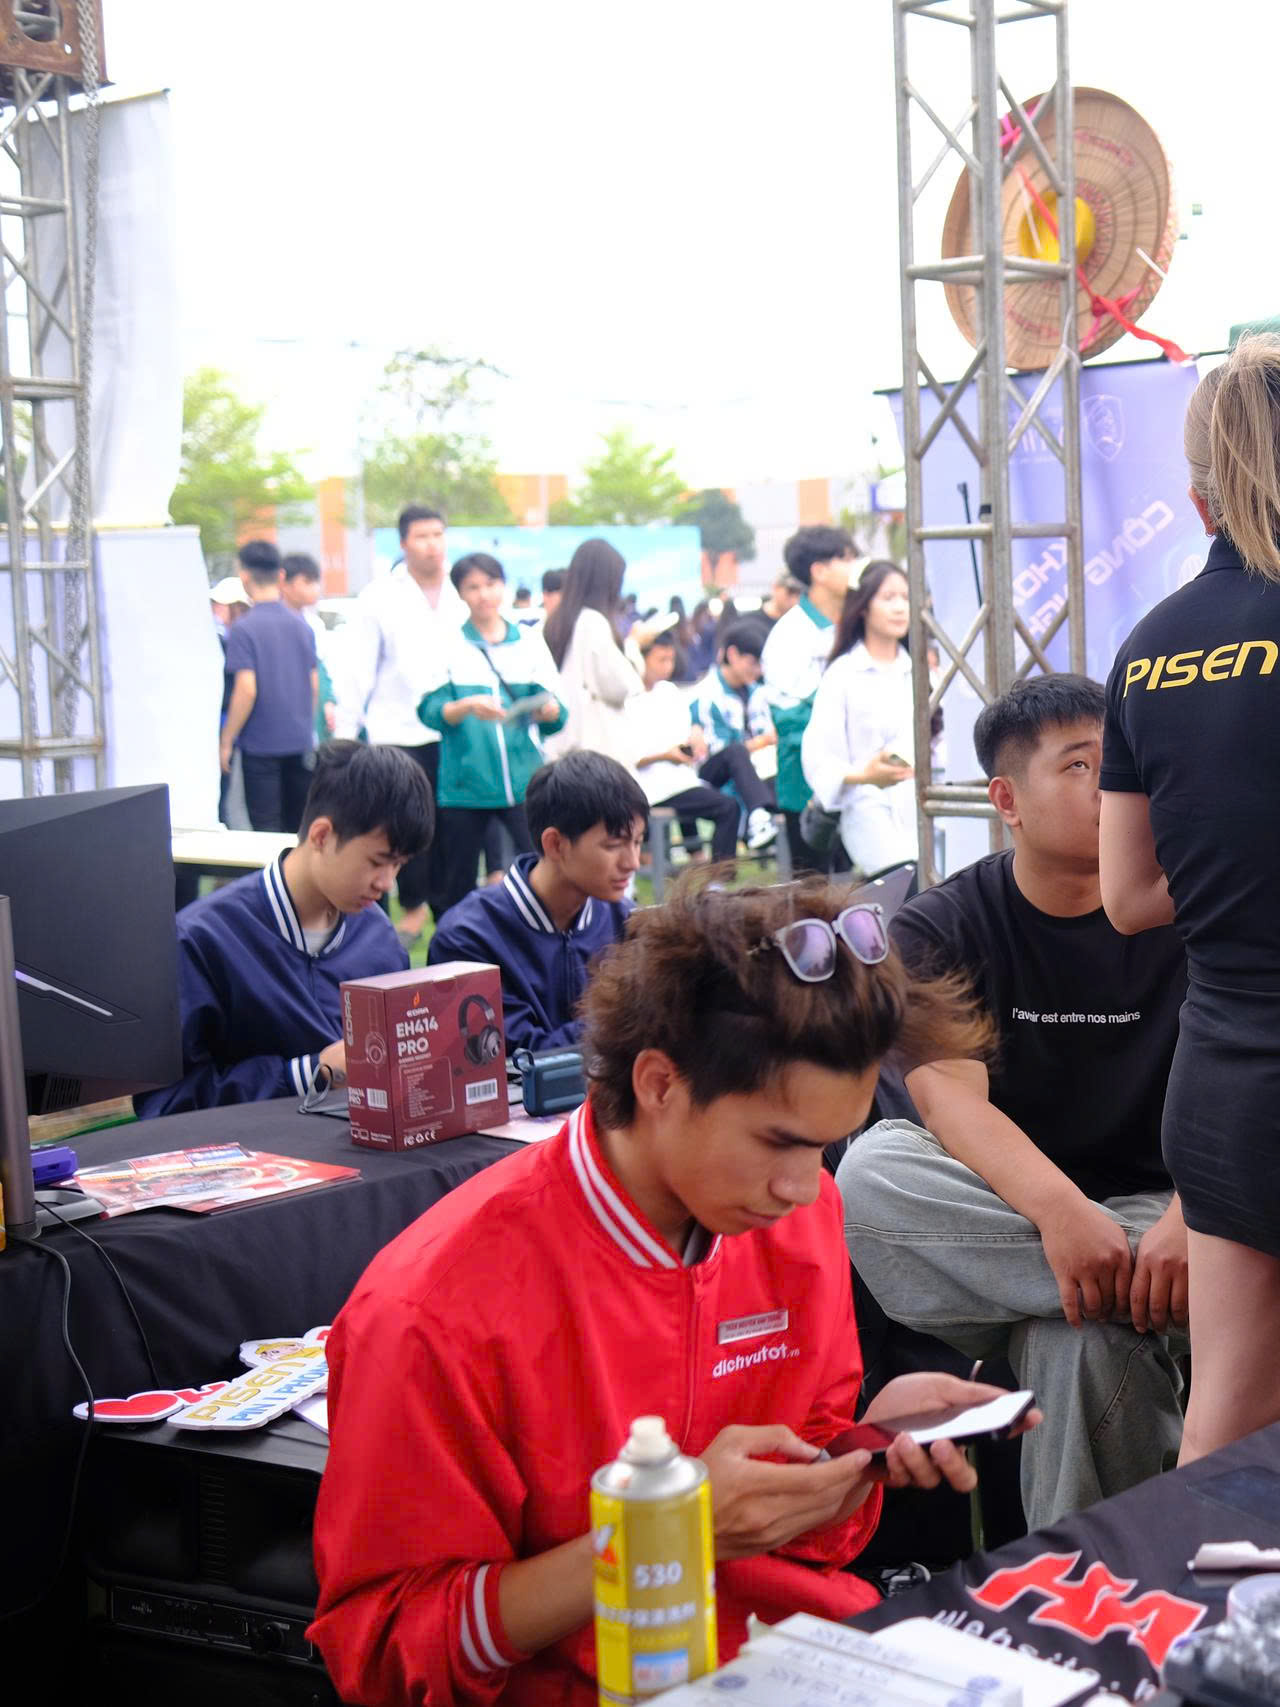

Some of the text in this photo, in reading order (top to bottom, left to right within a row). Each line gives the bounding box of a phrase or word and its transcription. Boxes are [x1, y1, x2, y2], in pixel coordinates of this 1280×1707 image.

[1123, 640, 1279, 698] PISEN
[396, 1015, 439, 1038] EH414
[1041, 1012, 1059, 1023] est
[1060, 1011, 1086, 1023] entre
[1087, 1013, 1107, 1024] nos
[1108, 1011, 1141, 1024] mains
[397, 1036, 429, 1057] PRO
[186, 1361, 306, 1421] PISEN
[634, 1561, 683, 1590] 530
